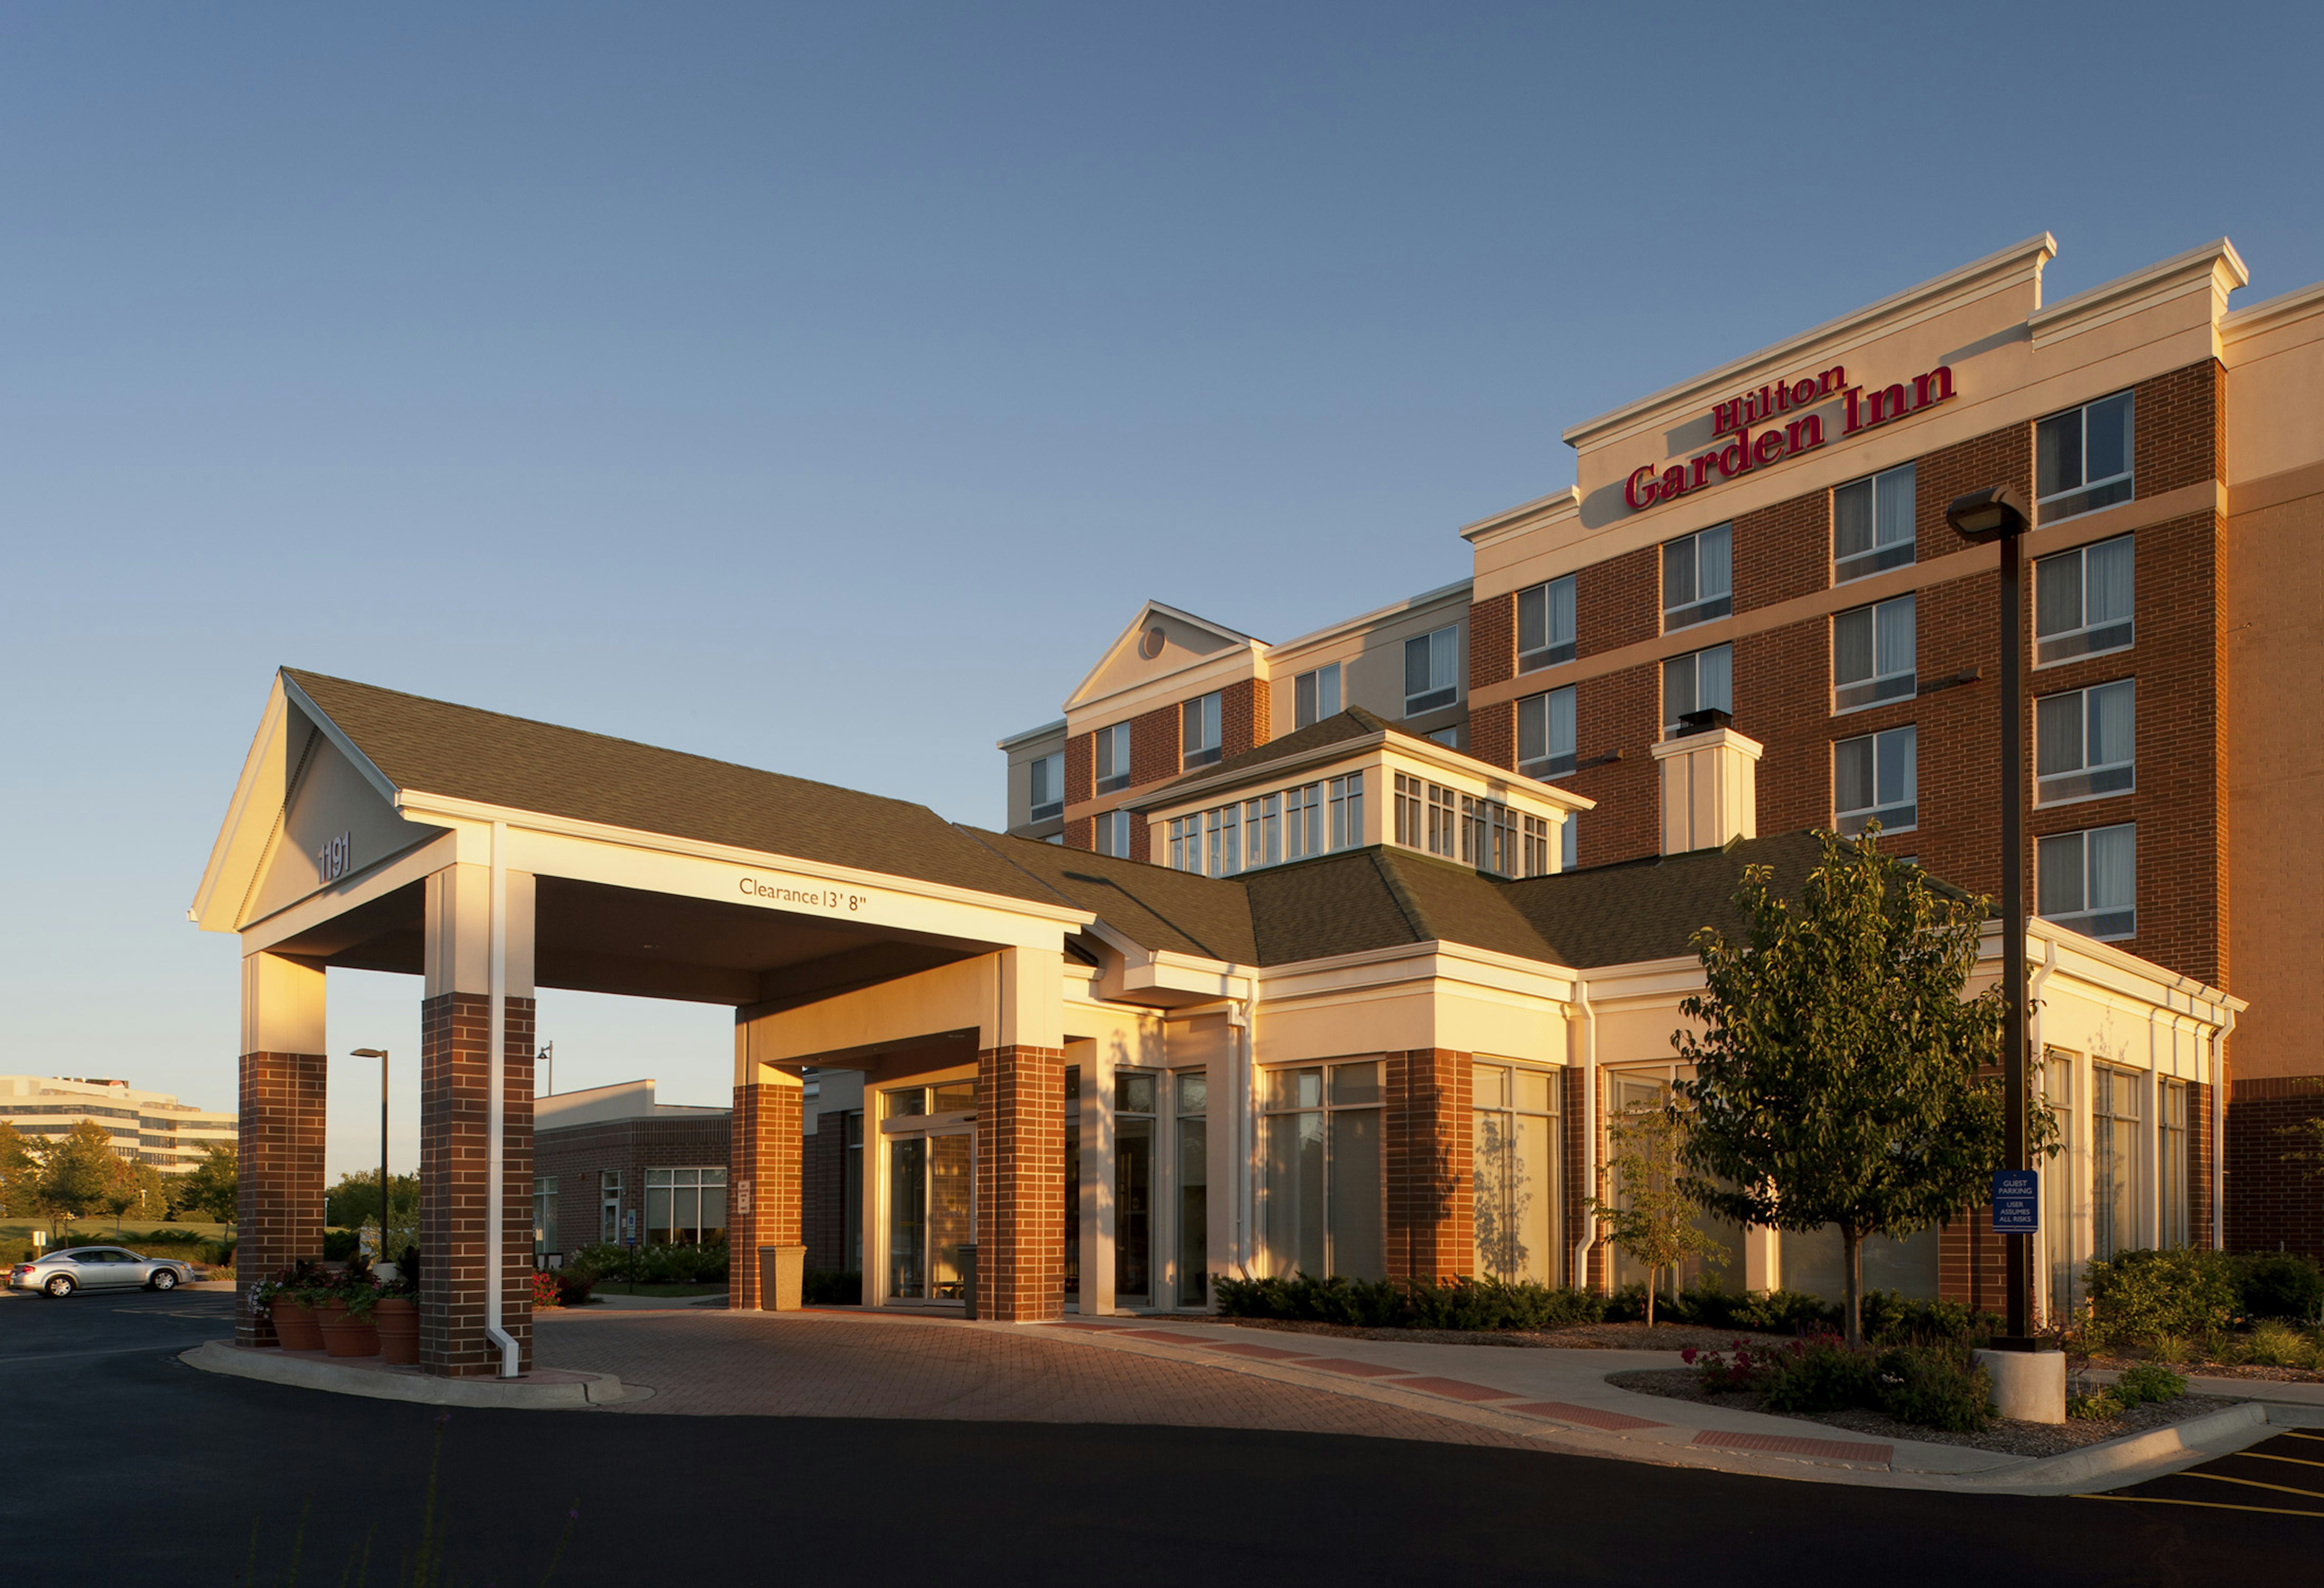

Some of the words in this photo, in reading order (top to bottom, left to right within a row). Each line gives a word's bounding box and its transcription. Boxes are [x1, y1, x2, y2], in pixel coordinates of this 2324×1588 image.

[1712, 365, 1848, 437] Hilton
[1624, 413, 1826, 511] Garden
[1841, 365, 1957, 437] Inn
[318, 830, 350, 885] 1191
[739, 878, 819, 905] Clearance
